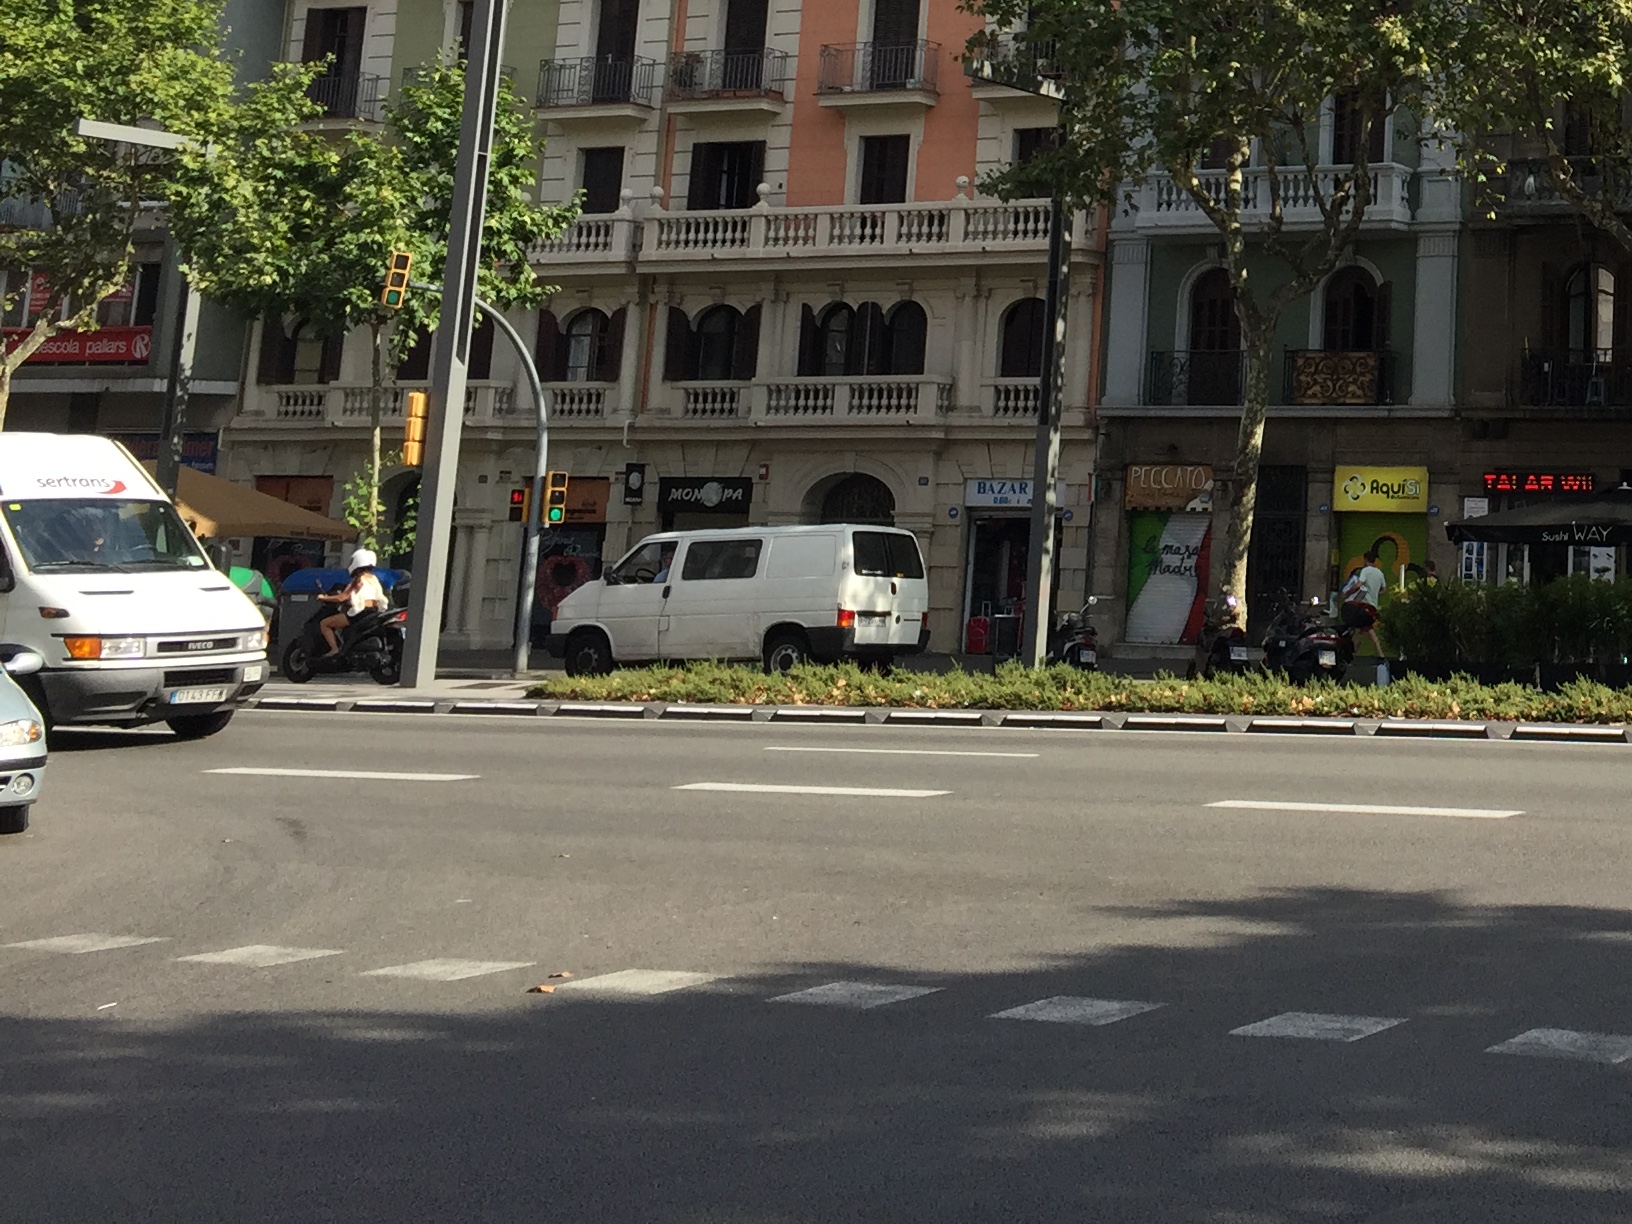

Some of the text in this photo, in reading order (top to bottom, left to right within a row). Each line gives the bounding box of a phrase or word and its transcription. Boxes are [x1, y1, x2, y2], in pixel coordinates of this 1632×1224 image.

[37, 476, 110, 487] sertrans
[1131, 467, 1205, 489] PECCATO
[978, 482, 1028, 495] BAZAR
[1573, 525, 1613, 542] WAY
[188, 641, 214, 650] IVECO
